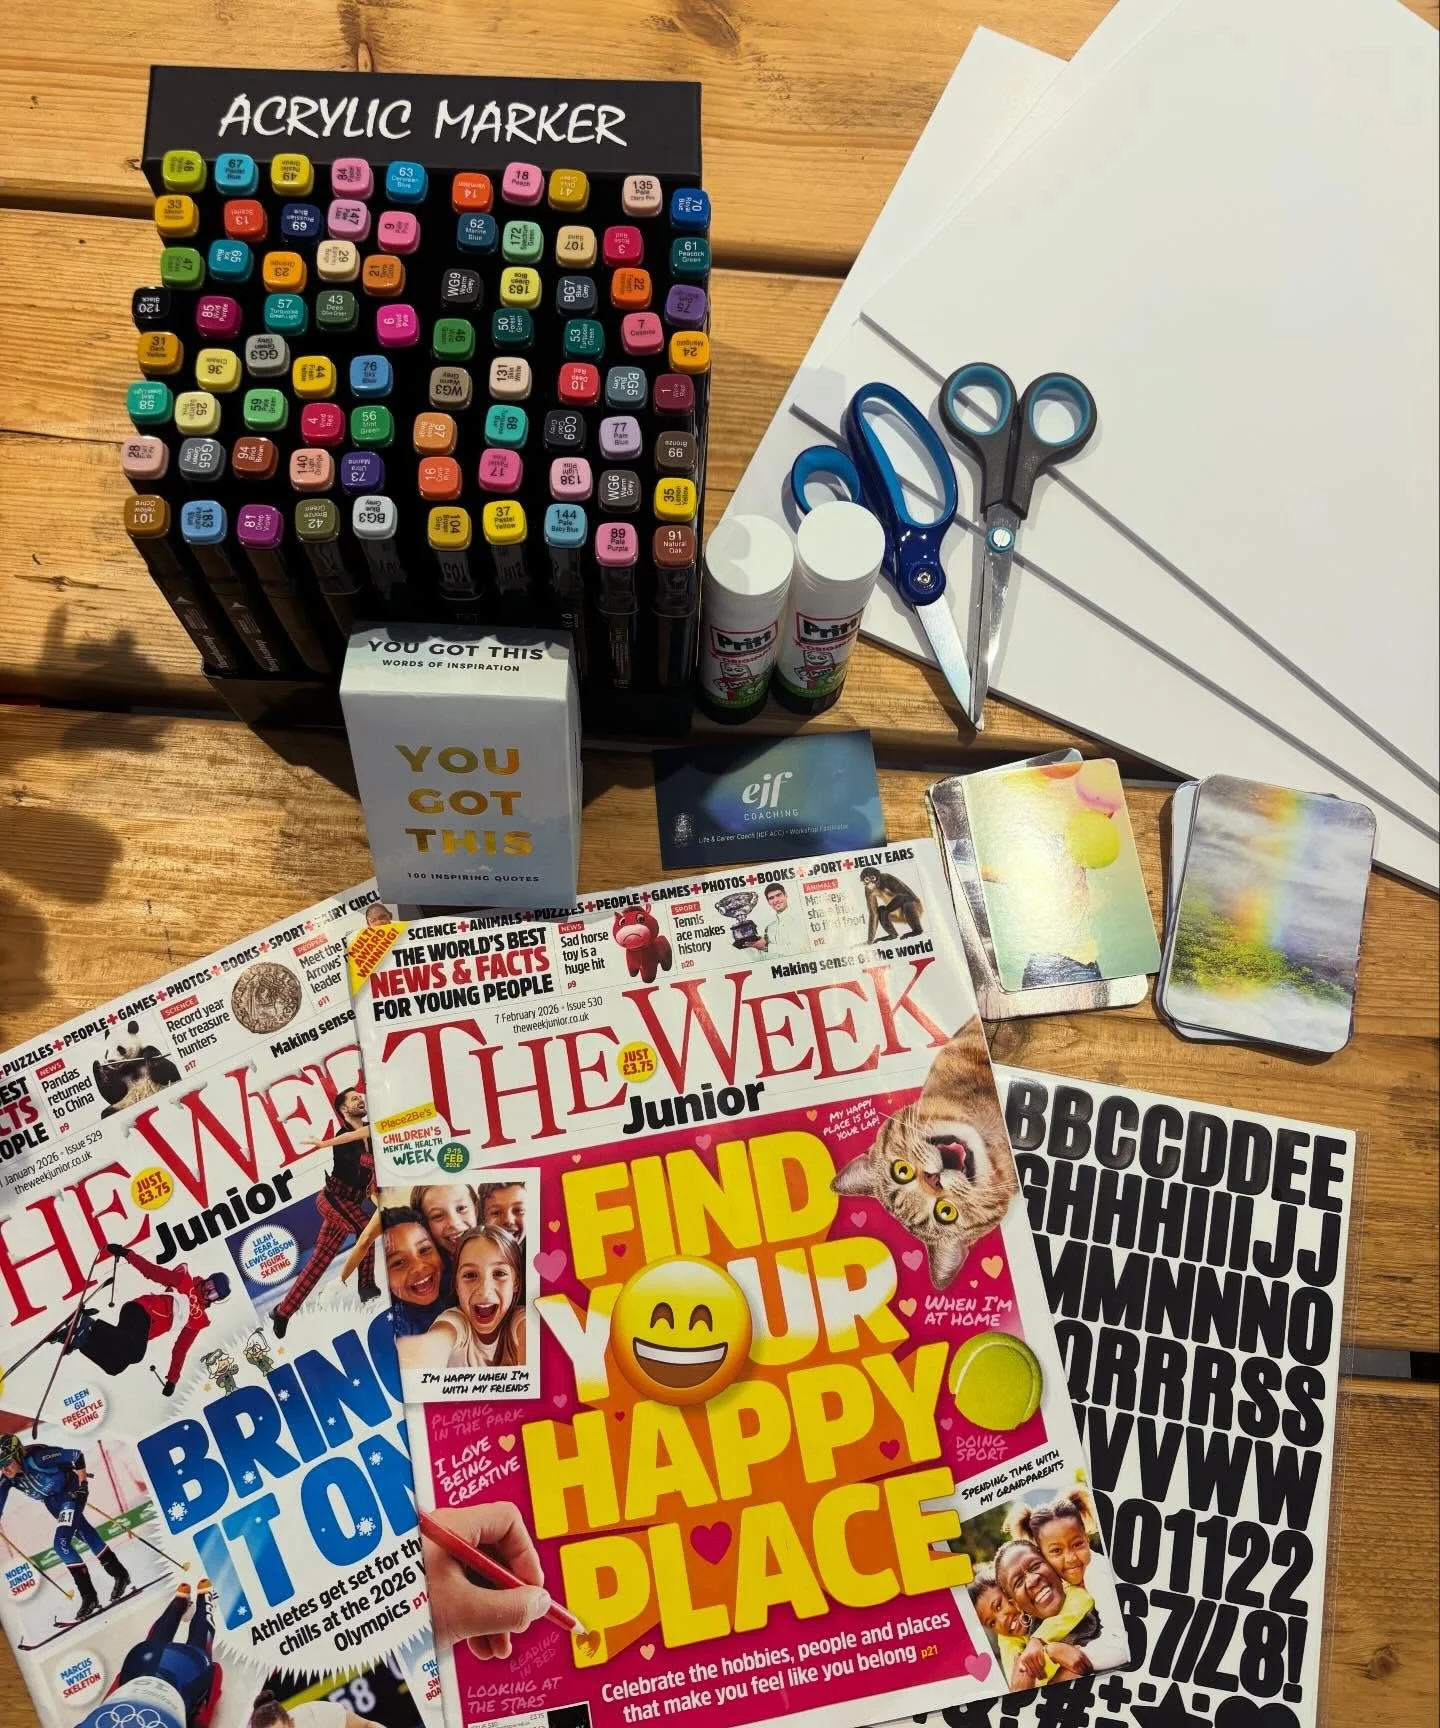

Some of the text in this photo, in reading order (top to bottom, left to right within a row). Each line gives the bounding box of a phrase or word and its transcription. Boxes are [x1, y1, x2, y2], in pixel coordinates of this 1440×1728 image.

[218, 93, 627, 146] ACRYLIC MARKER
[228, 160, 243, 168] 67
[399, 167, 414, 177] 63
[282, 172, 297, 181] 49
[516, 171, 529, 180] 18
[632, 181, 653, 190] 135
[235, 216, 249, 225] 13
[470, 219, 484, 229] 62
[564, 241, 585, 250] 107
[684, 242, 698, 250] 61
[447, 272, 461, 297] WG9
[563, 279, 576, 303] BG7
[138, 304, 160, 313] 120
[277, 299, 292, 308] 57
[328, 295, 343, 304] 43
[250, 350, 278, 360] GG3
[435, 384, 463, 396] WG3
[627, 372, 640, 396] BG5
[362, 411, 377, 421] 56
[612, 422, 627, 432] 77
[563, 415, 577, 440] CG9
[198, 443, 214, 469] GG5
[607, 475, 620, 501] WG6
[133, 512, 154, 524] 101
[358, 513, 386, 524] BG3
[495, 506, 510, 517] 37
[554, 510, 577, 520] 144
[610, 528, 626, 538] 89
[667, 530, 682, 541] 91
[669, 547, 683, 555] Oak
[368, 640, 544, 660] YOU GOT THIS
[717, 630, 772, 651] Pritt
[382, 659, 425, 668] WORDS
[447, 662, 520, 672] INSPIRATION
[395, 744, 520, 776] YOU
[742, 771, 793, 810] ejf
[408, 788, 522, 816] GOT
[744, 809, 800, 822] COACHING
[405, 828, 534, 856] THIS
[407, 872, 541, 883] 100 INSPIRING QUOTES
[408, 847, 915, 941] SCIENCE ANIMALS PEOPLE GAMES PHOTOS BOOKS JELLY EARS
[673, 913, 706, 930] Tennis
[694, 923, 727, 940] makes
[392, 926, 548, 968] THE WORLD'S BEST
[560, 929, 610, 948] Sad horse
[677, 939, 713, 957] history
[770, 940, 934, 980] Making world
[310, 972, 342, 994] leader
[369, 946, 551, 999] NEWS & FACTS
[4, 924, 305, 1077] PUZZLES PEOPLE GAMES PHOTOS BOOKS SPORT
[373, 973, 555, 1022] FOR YOUNG PEOPLE
[166, 998, 225, 1033] Record year
[501, 1003, 560, 1025] February 2026
[512, 1011, 590, 1034] theweekjunior.co.uk
[188, 1012, 231, 1041] treasure
[270, 1009, 357, 1058] Making sense
[178, 1033, 218, 1059] hunters
[381, 957, 954, 1149] THE WEEK
[623, 1047, 649, 1062] JUST
[622, 1059, 654, 1076] £3.75
[41, 1067, 81, 1094] Pandas
[47, 1076, 93, 1107] returned
[66, 1091, 95, 1114] China
[622, 1081, 766, 1135] Junior
[380, 1106, 433, 1131] Place2Be's
[382, 1126, 442, 1144] CHILDREN'S
[392, 1149, 435, 1166] WEEK
[442, 1154, 464, 1164] FEB
[136, 1171, 164, 1194] JUST
[138, 1181, 172, 1207] £3.75
[560, 1130, 840, 1280] FIND
[155, 1169, 294, 1265] Junior
[924, 1294, 977, 1312] WHEN
[924, 1311, 1001, 1327] AT HOME
[443, 1371, 508, 1384] HAPPY WHEN
[489, 1382, 531, 1394] FRIENDS
[63, 1387, 91, 1408] EILEEN
[62, 1399, 104, 1426] FREESTYLE
[450, 1435, 493, 1468] LOVE
[521, 1341, 951, 1540] HAPPY
[955, 1435, 1007, 1448] DOING
[956, 1446, 1009, 1462] SPORT
[440, 1455, 493, 1492] BEING
[448, 1455, 522, 1506] CREATIVE
[961, 1461, 1035, 1500] SPENDING TIME
[996, 1459, 1065, 1498] GRANDPARENTS
[193, 1492, 296, 1631] IT
[559, 1466, 975, 1669] PLACE
[250, 1551, 400, 1646] Athletes get set for
[279, 1564, 418, 1657] chills the 2026
[333, 1598, 412, 1653] Olympics
[60, 1656, 94, 1681] MARCUS
[601, 1612, 952, 1703] Celebrate the hobbies, people and places
[65, 1667, 92, 1687] WYATT
[467, 1677, 538, 1699] LOOKING
[622, 1643, 940, 1724] that make you feel like you belong p21
[500, 1693, 546, 1715] STARS
